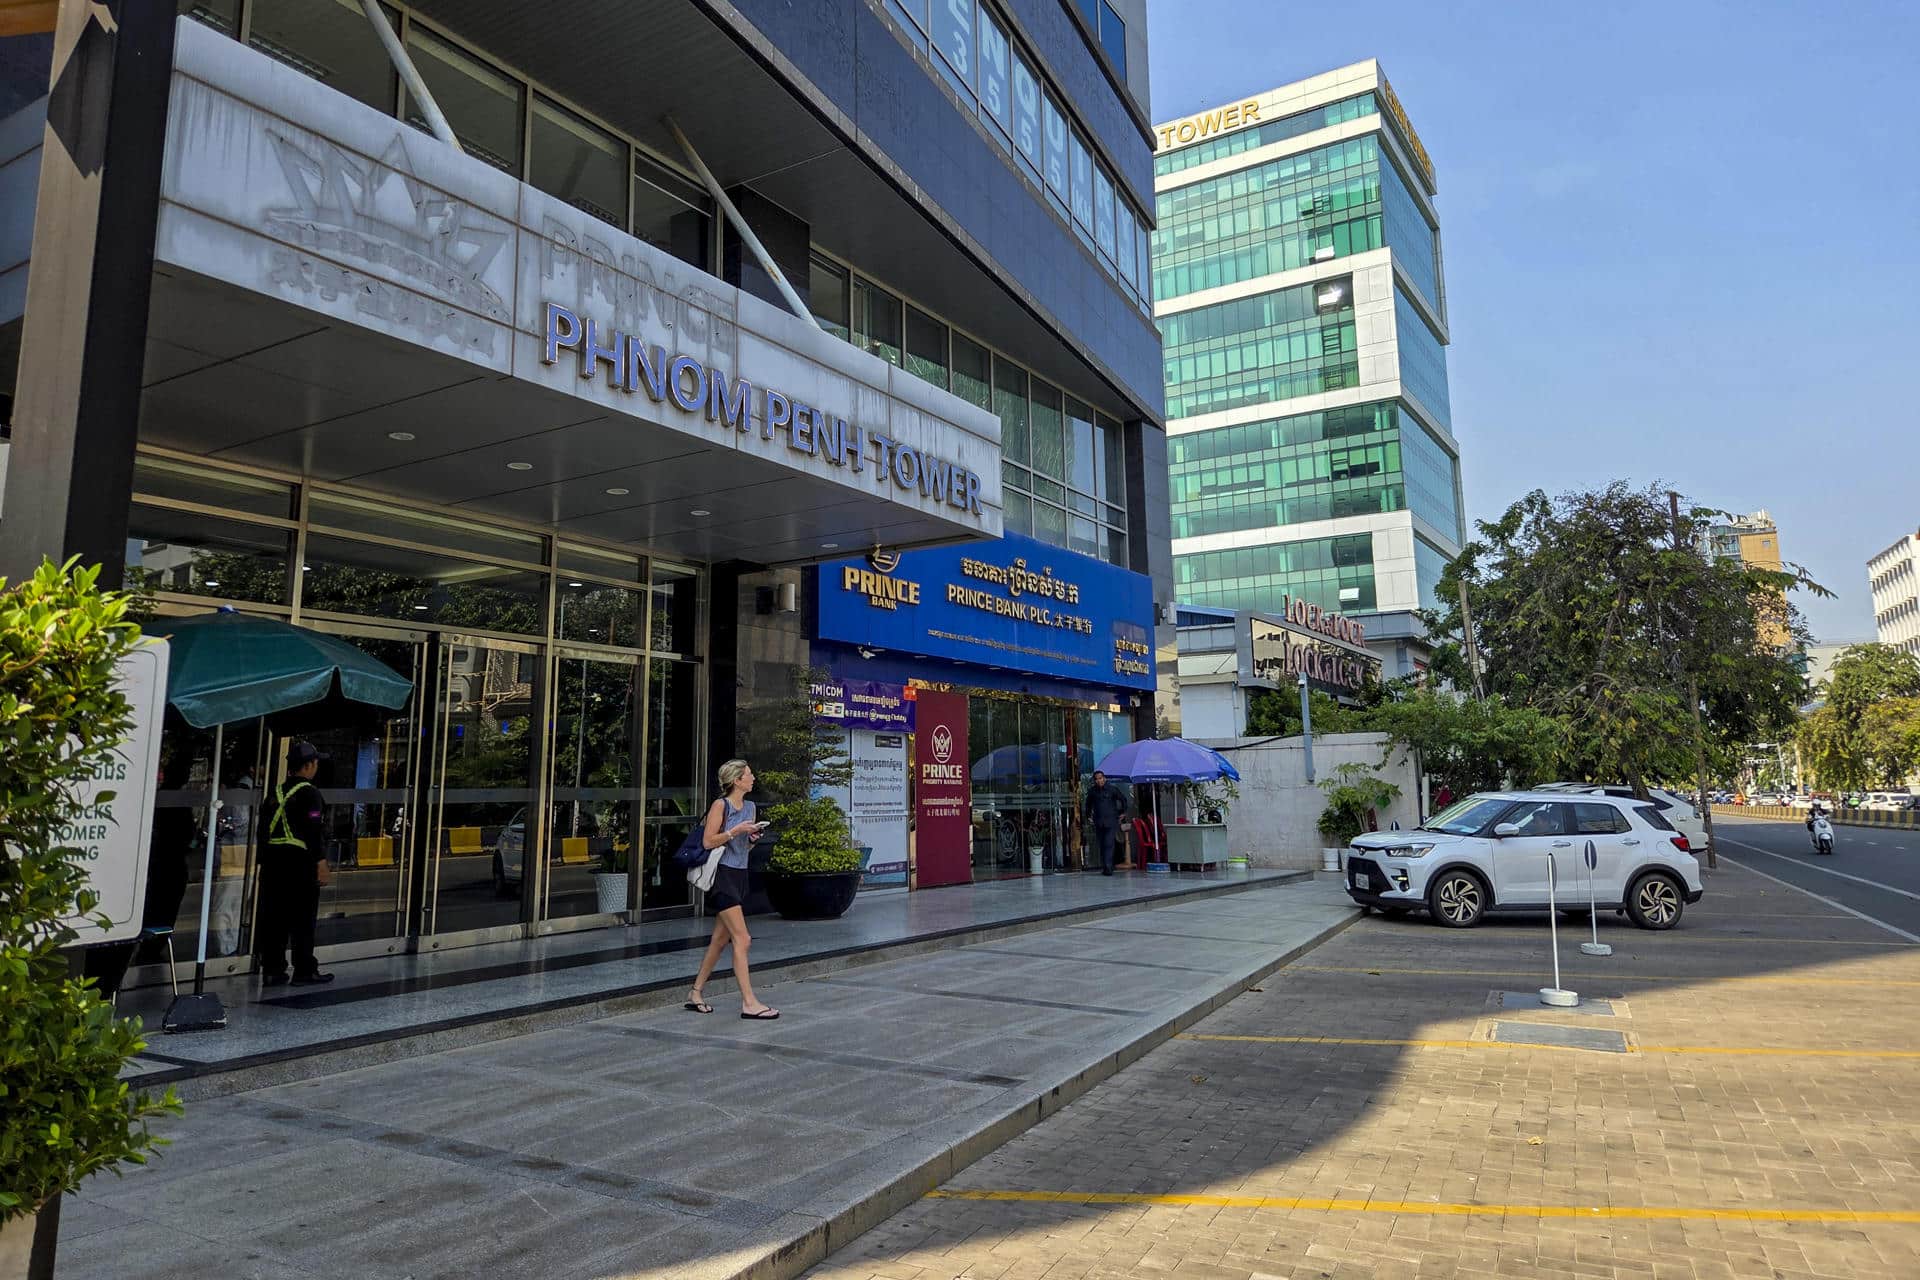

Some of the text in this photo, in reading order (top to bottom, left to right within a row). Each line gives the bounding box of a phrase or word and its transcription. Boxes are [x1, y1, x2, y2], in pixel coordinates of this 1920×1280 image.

[1160, 100, 1261, 148] TOWER
[543, 302, 984, 516] PHNOM PENH TOWER
[842, 565, 920, 606] PRINCE
[870, 595, 898, 611] BANK
[946, 583, 993, 612] PRINCE
[995, 596, 1028, 621] BANK
[1029, 605, 1054, 626] PLC.
[922, 763, 963, 779] PRINCE
